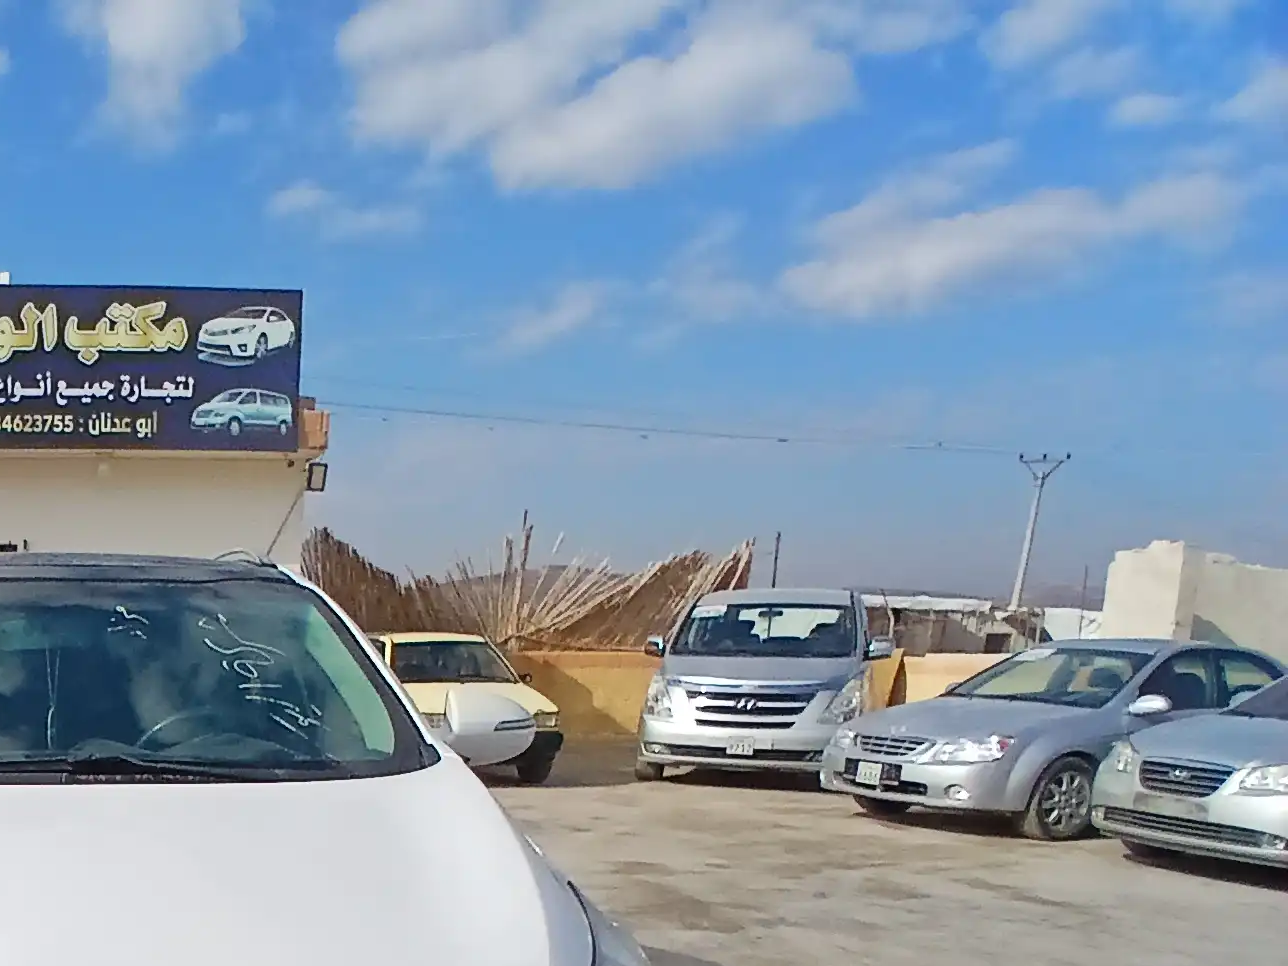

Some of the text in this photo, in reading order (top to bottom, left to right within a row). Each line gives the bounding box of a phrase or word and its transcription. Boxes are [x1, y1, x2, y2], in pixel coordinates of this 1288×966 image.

[65, 301, 188, 365] مكتب
[56, 379, 115, 405] جميع
[120, 374, 194, 403] لتجارة
[88, 411, 132, 436] عدنان
